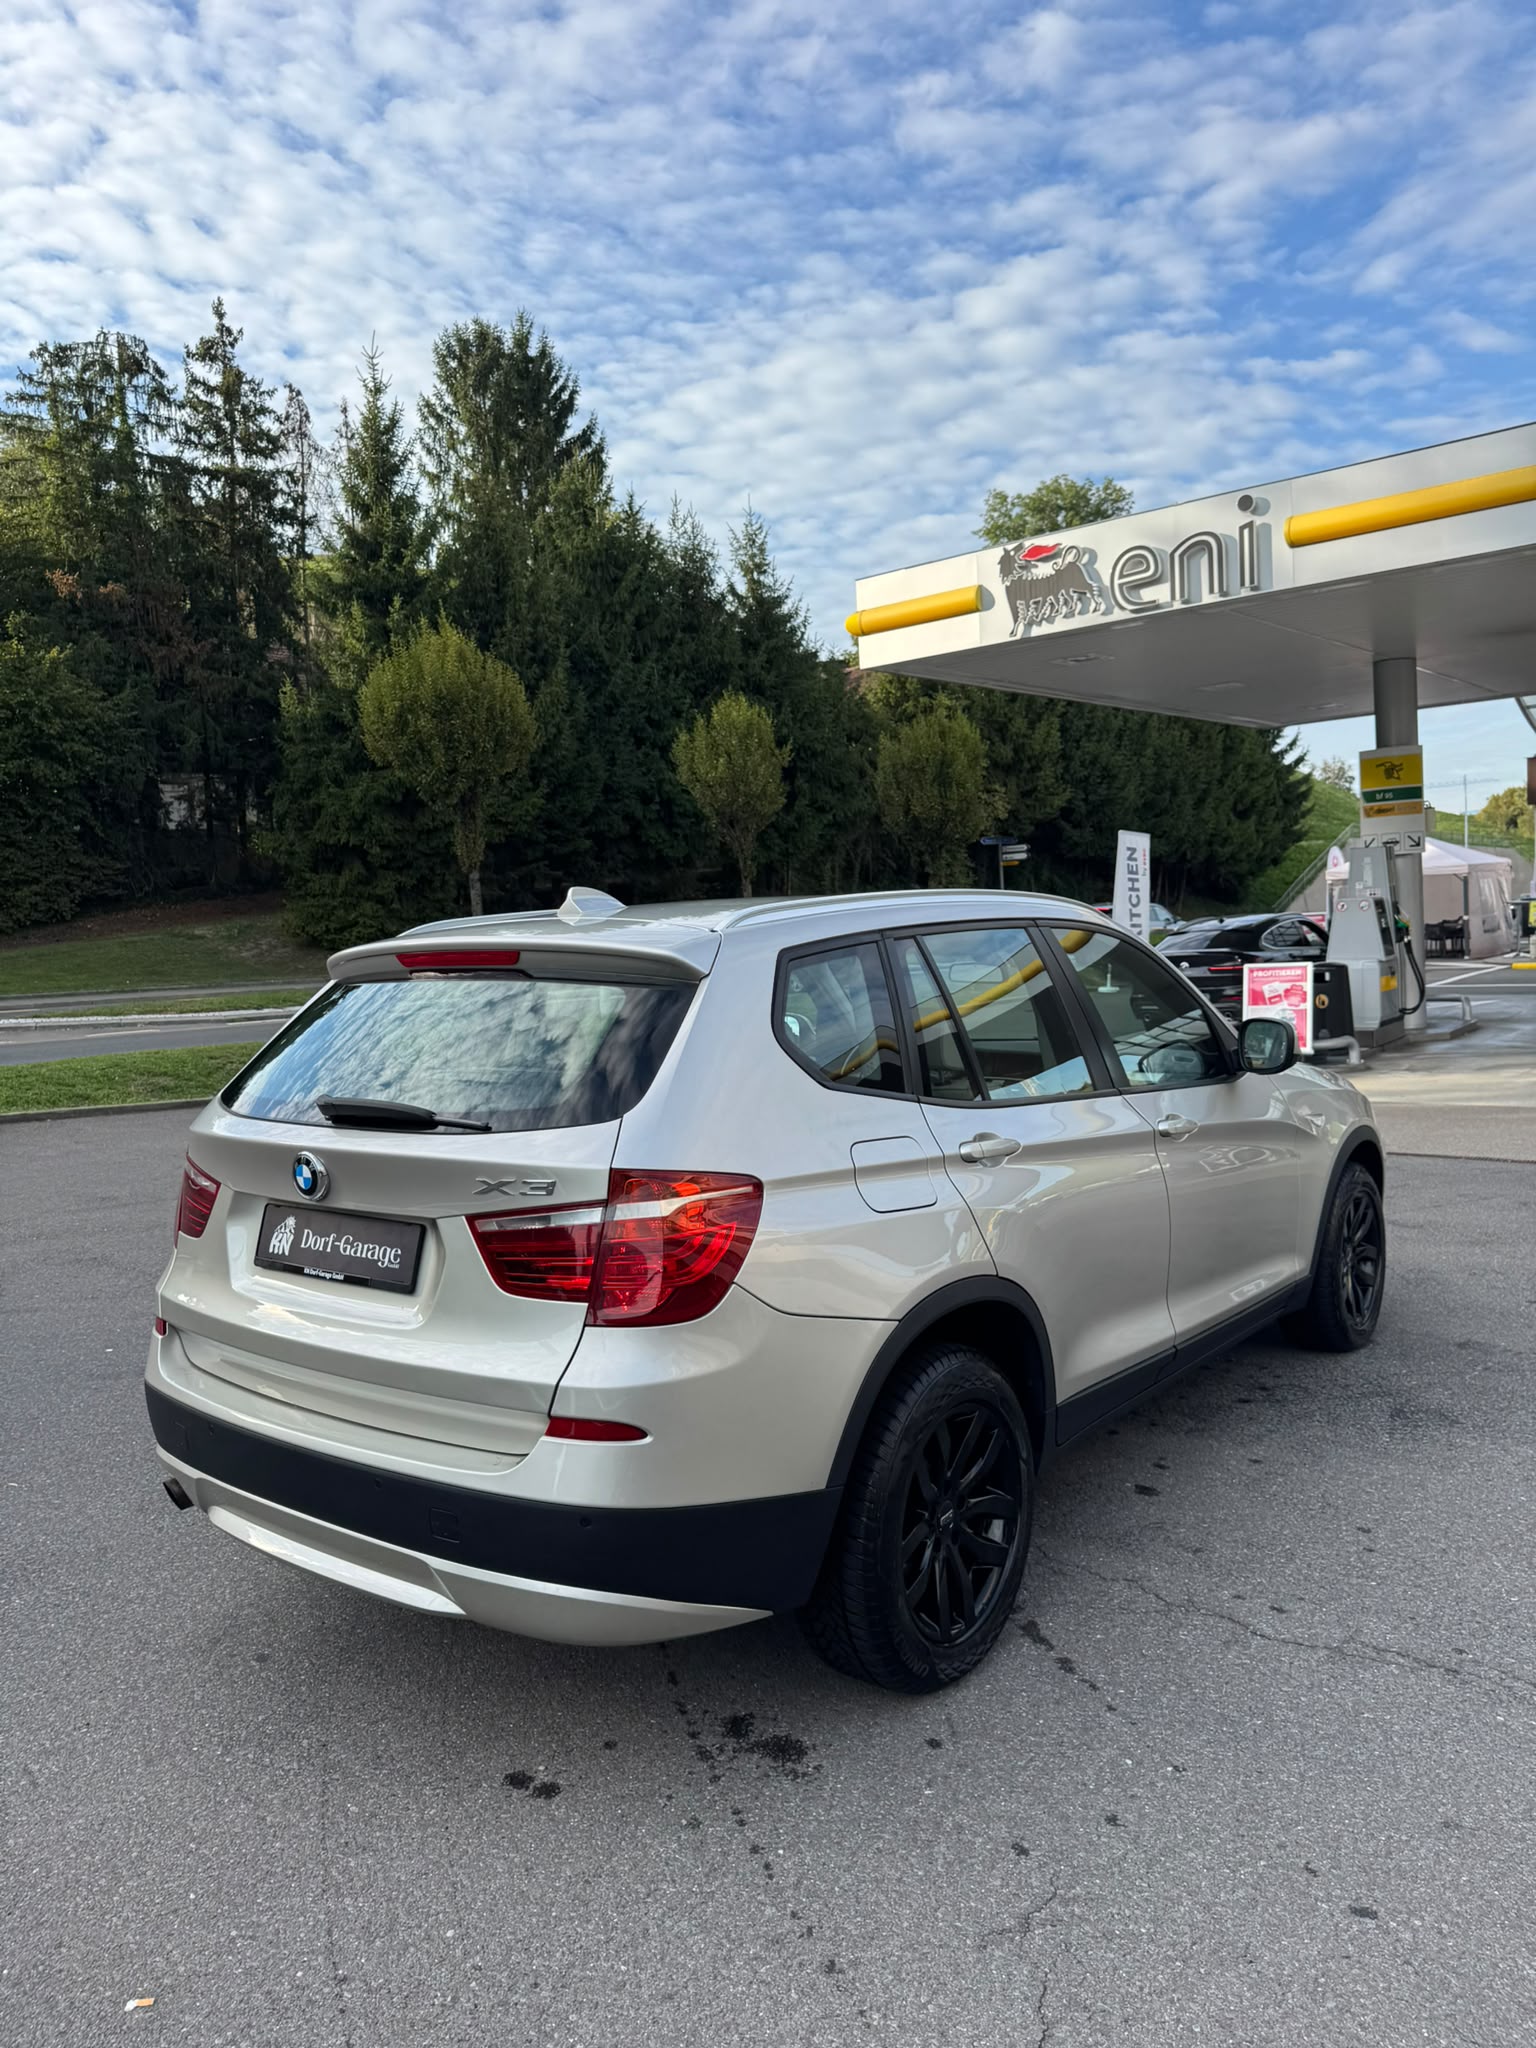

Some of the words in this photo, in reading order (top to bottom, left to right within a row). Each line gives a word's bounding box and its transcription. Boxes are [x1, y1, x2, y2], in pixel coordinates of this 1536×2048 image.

[1110, 494, 1258, 613] eni
[472, 1177, 557, 1197] X3
[301, 1229, 402, 1268] Dorf-Garage
